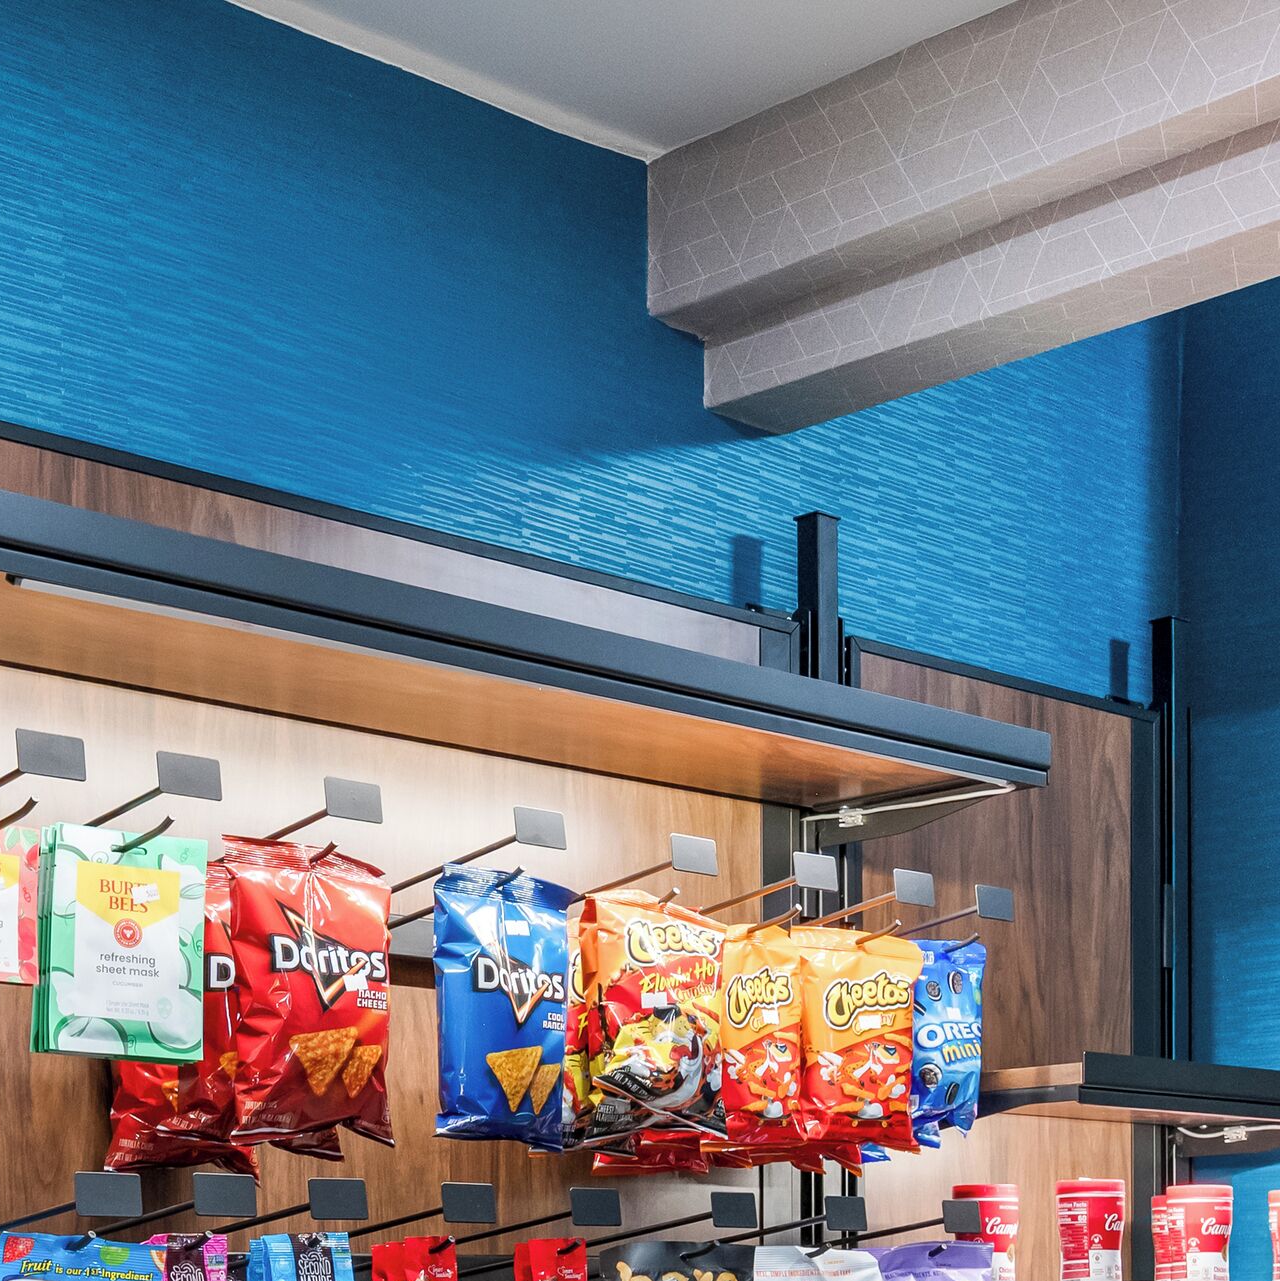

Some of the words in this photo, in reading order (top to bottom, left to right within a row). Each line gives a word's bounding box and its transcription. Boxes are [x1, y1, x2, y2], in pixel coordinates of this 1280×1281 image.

[100, 953, 155, 967] refreshing
[268, 933, 386, 983] Doritos
[96, 964, 126, 974] sheet
[129, 968, 159, 977] mask
[473, 957, 564, 999] Doritos
[357, 988, 387, 1001] NACHO
[675, 982, 714, 1001] Crunchy
[728, 969, 790, 1026] Cheetos
[826, 973, 909, 1026] Cheetos
[357, 998, 387, 1010] CHEESE
[298, 1255, 333, 1275] SECOND
